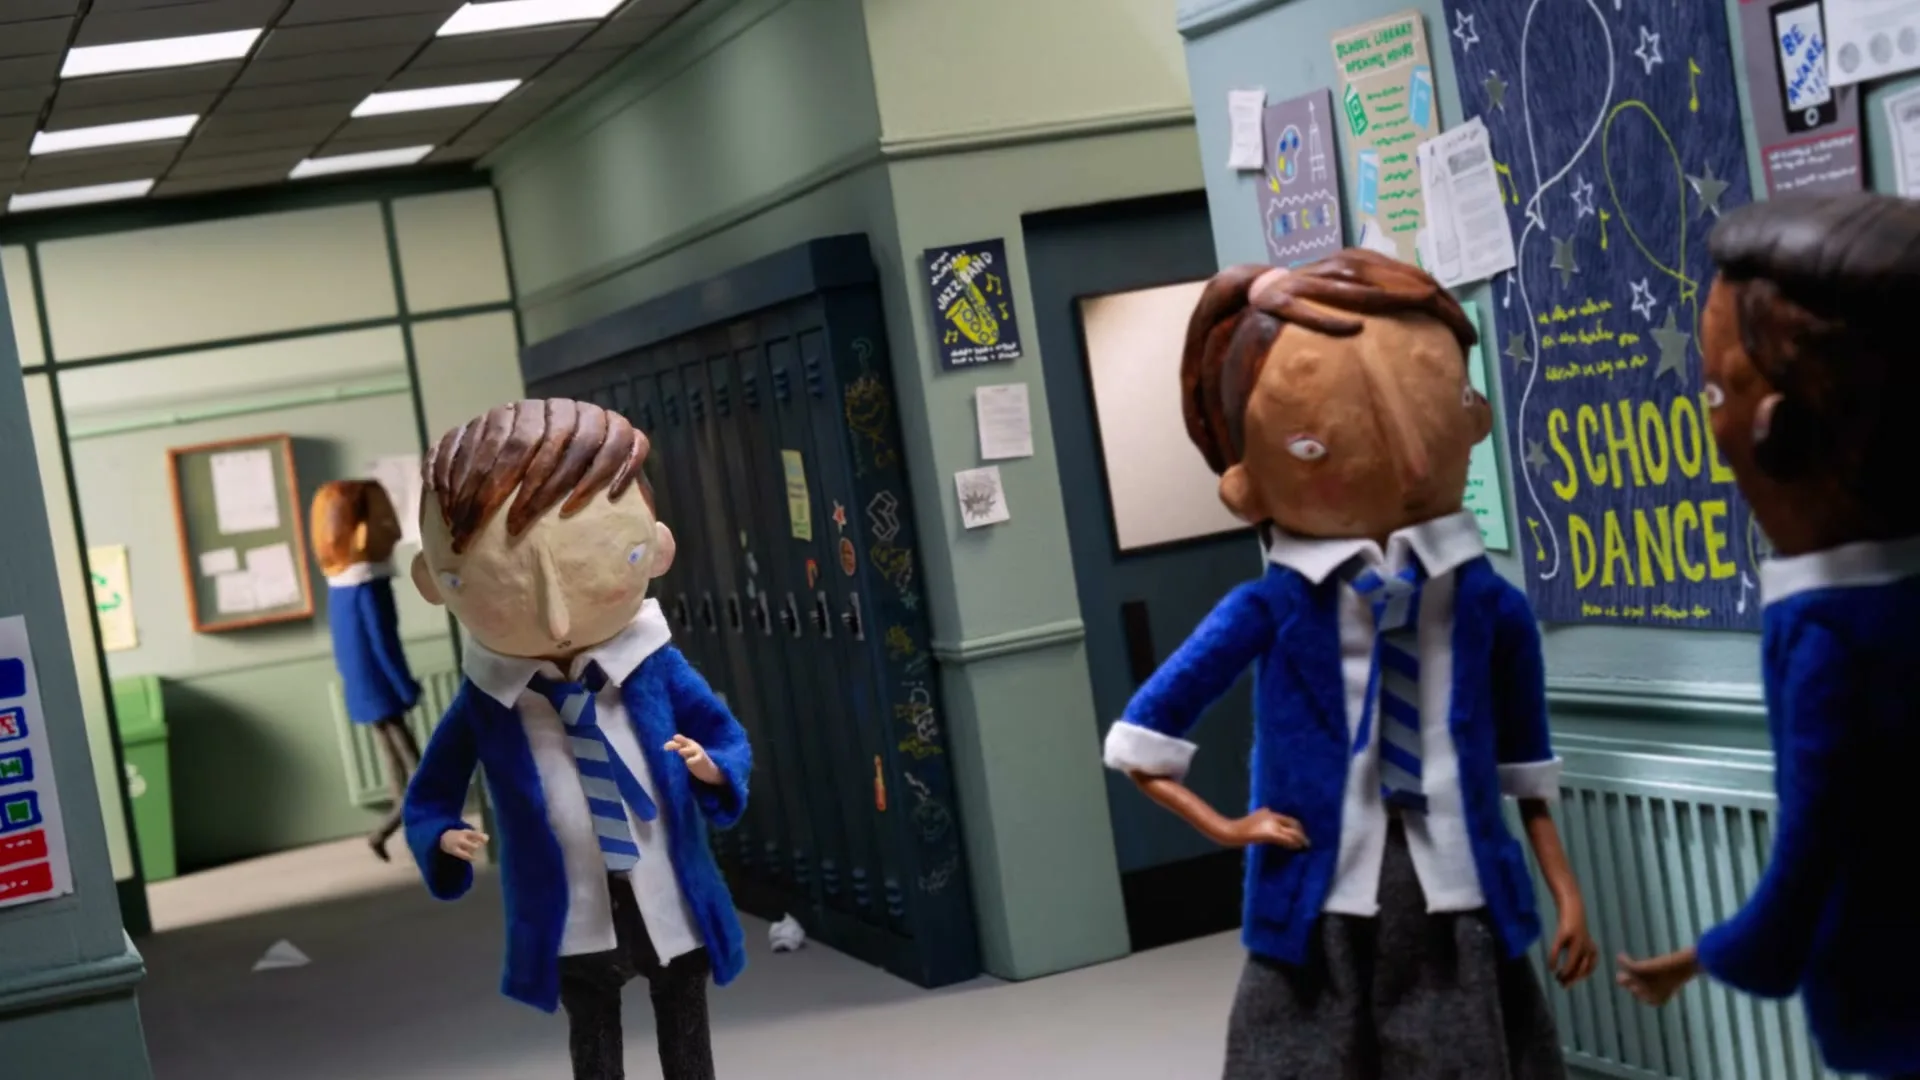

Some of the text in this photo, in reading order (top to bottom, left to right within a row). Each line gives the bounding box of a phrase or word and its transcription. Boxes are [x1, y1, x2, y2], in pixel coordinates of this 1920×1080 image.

[1335, 22, 1413, 59] SCHOOL LIBRARY
[1345, 41, 1414, 73] OPENING HOURS
[1782, 23, 1804, 57] BE
[1788, 32, 1825, 104] AWARE
[1274, 211, 1297, 237] ART
[937, 280, 962, 311] JAZZ
[959, 251, 993, 285] BAND
[1548, 391, 1737, 502] SCHOOL
[1568, 500, 1737, 591] DANCE
